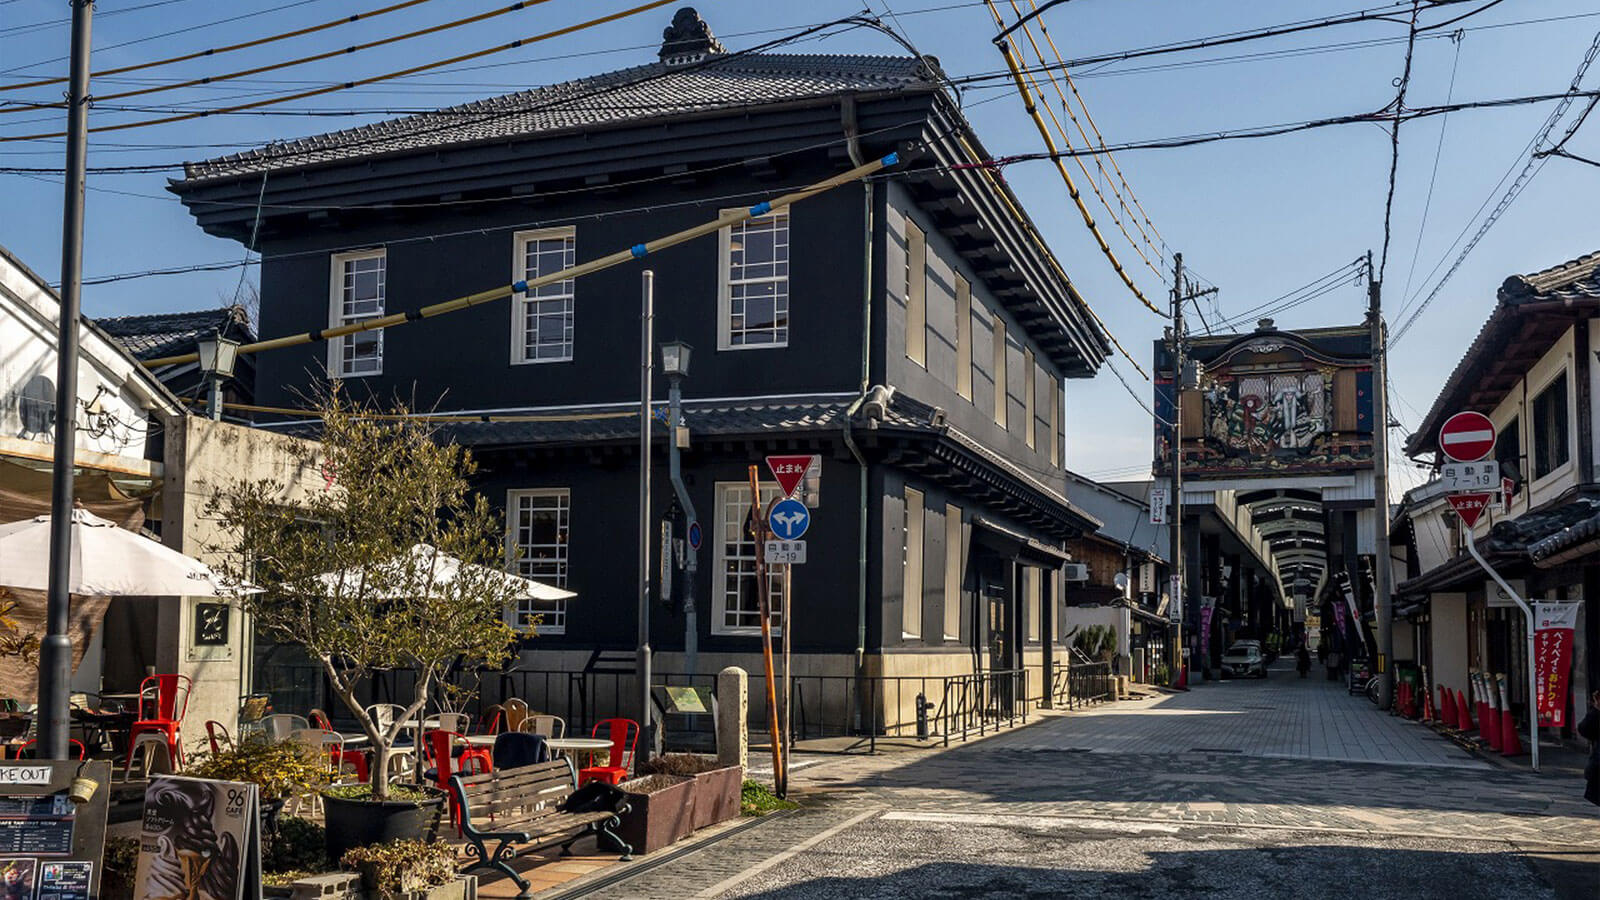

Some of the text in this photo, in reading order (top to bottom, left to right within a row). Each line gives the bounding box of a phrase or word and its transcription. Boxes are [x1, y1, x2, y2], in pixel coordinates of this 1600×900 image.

[776, 464, 803, 474] 止まれ
[1446, 465, 1494, 477] 自動車
[1452, 475, 1490, 487] 7-19
[1457, 501, 1482, 509] 止まれ
[774, 552, 796, 561] 7-19
[21, 768, 49, 781] OUT
[227, 789, 244, 806] 96
